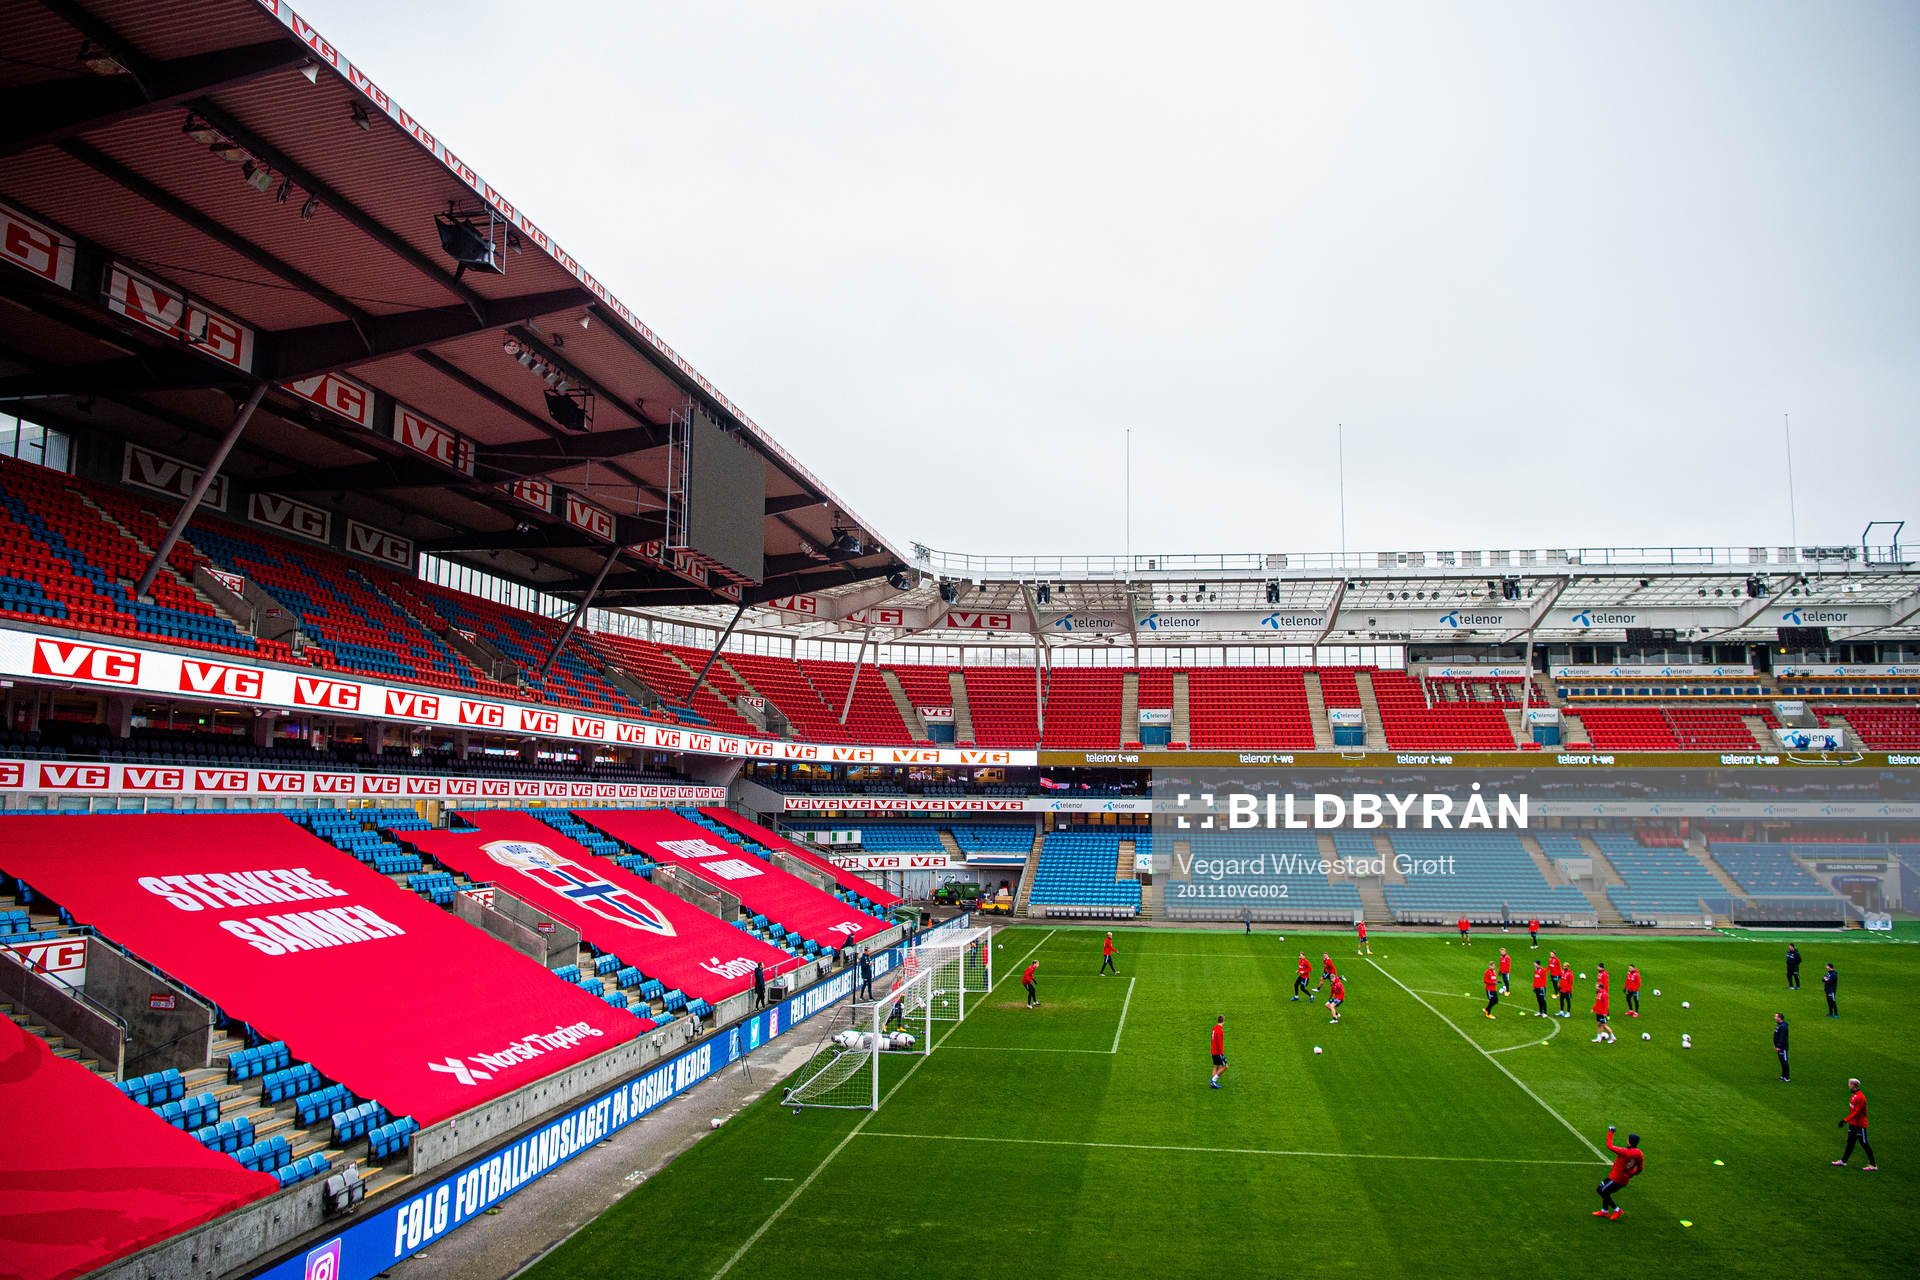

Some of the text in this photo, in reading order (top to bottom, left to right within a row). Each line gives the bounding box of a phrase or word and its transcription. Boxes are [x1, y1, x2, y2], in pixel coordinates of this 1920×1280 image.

[294, 15, 336, 67] VG
[351, 66, 389, 111] VG
[401, 109, 434, 151] VG
[446, 150, 475, 188] VG
[486, 185, 513, 219] VG
[522, 217, 547, 249] VG
[554, 246, 577, 275] VG
[584, 271, 605, 298] VG
[610, 296, 629, 320] VG
[131, 277, 236, 360] VG
[635, 318, 652, 340] VG
[405, 416, 466, 471] VG
[136, 451, 218, 504] VG
[259, 493, 323, 536] VG
[572, 501, 609, 537] VG
[354, 527, 409, 563] VG
[774, 596, 814, 613] VG
[950, 613, 1009, 628] VG
[1074, 616, 1115, 628] telenor
[1159, 617, 1200, 628] telenor
[1280, 616, 1323, 626] telenor
[1459, 614, 1503, 625] telenor
[1591, 613, 1635, 624] telenor
[1803, 612, 1848, 622] telenor
[39, 641, 135, 682] VG
[184, 662, 259, 698] VG
[297, 678, 358, 710] VG
[389, 692, 437, 719] VG
[923, 708, 951, 716] VG
[462, 702, 502, 727] VG
[523, 710, 557, 733] VG
[574, 717, 603, 739] VG
[618, 725, 644, 743] VG
[657, 730, 680, 747] VG
[691, 735, 710, 751] VG
[721, 739, 737, 754] VG
[746, 742, 772, 756] VG
[786, 744, 816, 759] VG
[834, 749, 872, 761] VG
[894, 751, 938, 762] VG
[962, 752, 1009, 763] VG
[1086, 754, 1117, 763] telenor
[1239, 754, 1271, 764] telenor
[1397, 755, 1429, 765] telenor
[1557, 755, 1590, 765] telenor
[1721, 755, 1755, 765] telenor
[44, 766, 107, 787] VG
[126, 769, 182, 788] VG
[198, 772, 245, 789] VG
[261, 775, 302, 791] VG
[316, 776, 353, 792] VG
[365, 778, 398, 793] VG
[409, 780, 438, 793] VG
[449, 781, 476, 794] VG
[483, 782, 508, 794] VG
[515, 783, 538, 795] VG
[545, 783, 566, 795] VG
[572, 785, 591, 796] VG
[598, 785, 615, 797] VG
[620, 786, 636, 797] VG
[641, 787, 657, 797] VG
[661, 788, 675, 797] VG
[679, 788, 692, 798] VG
[696, 788, 709, 798] VG
[712, 788, 724, 798] VG
[786, 799, 810, 809] VG
[812, 800, 839, 810] VG
[842, 800, 870, 810] VG
[875, 800, 907, 810] VG
[911, 801, 943, 810] VG
[949, 801, 982, 810] VG
[988, 801, 1023, 810] VG
[868, 858, 898, 867] VG
[912, 857, 945, 866] VG
[137, 868, 349, 911] STERKERE
[219, 905, 406, 956] SAMMEN
[467, 1021, 604, 1072] Norsk Tipping
[394, 1043, 711, 1258] FØLG FOTBALLANDSLAGET PÅ SOSIALE MEDIER
